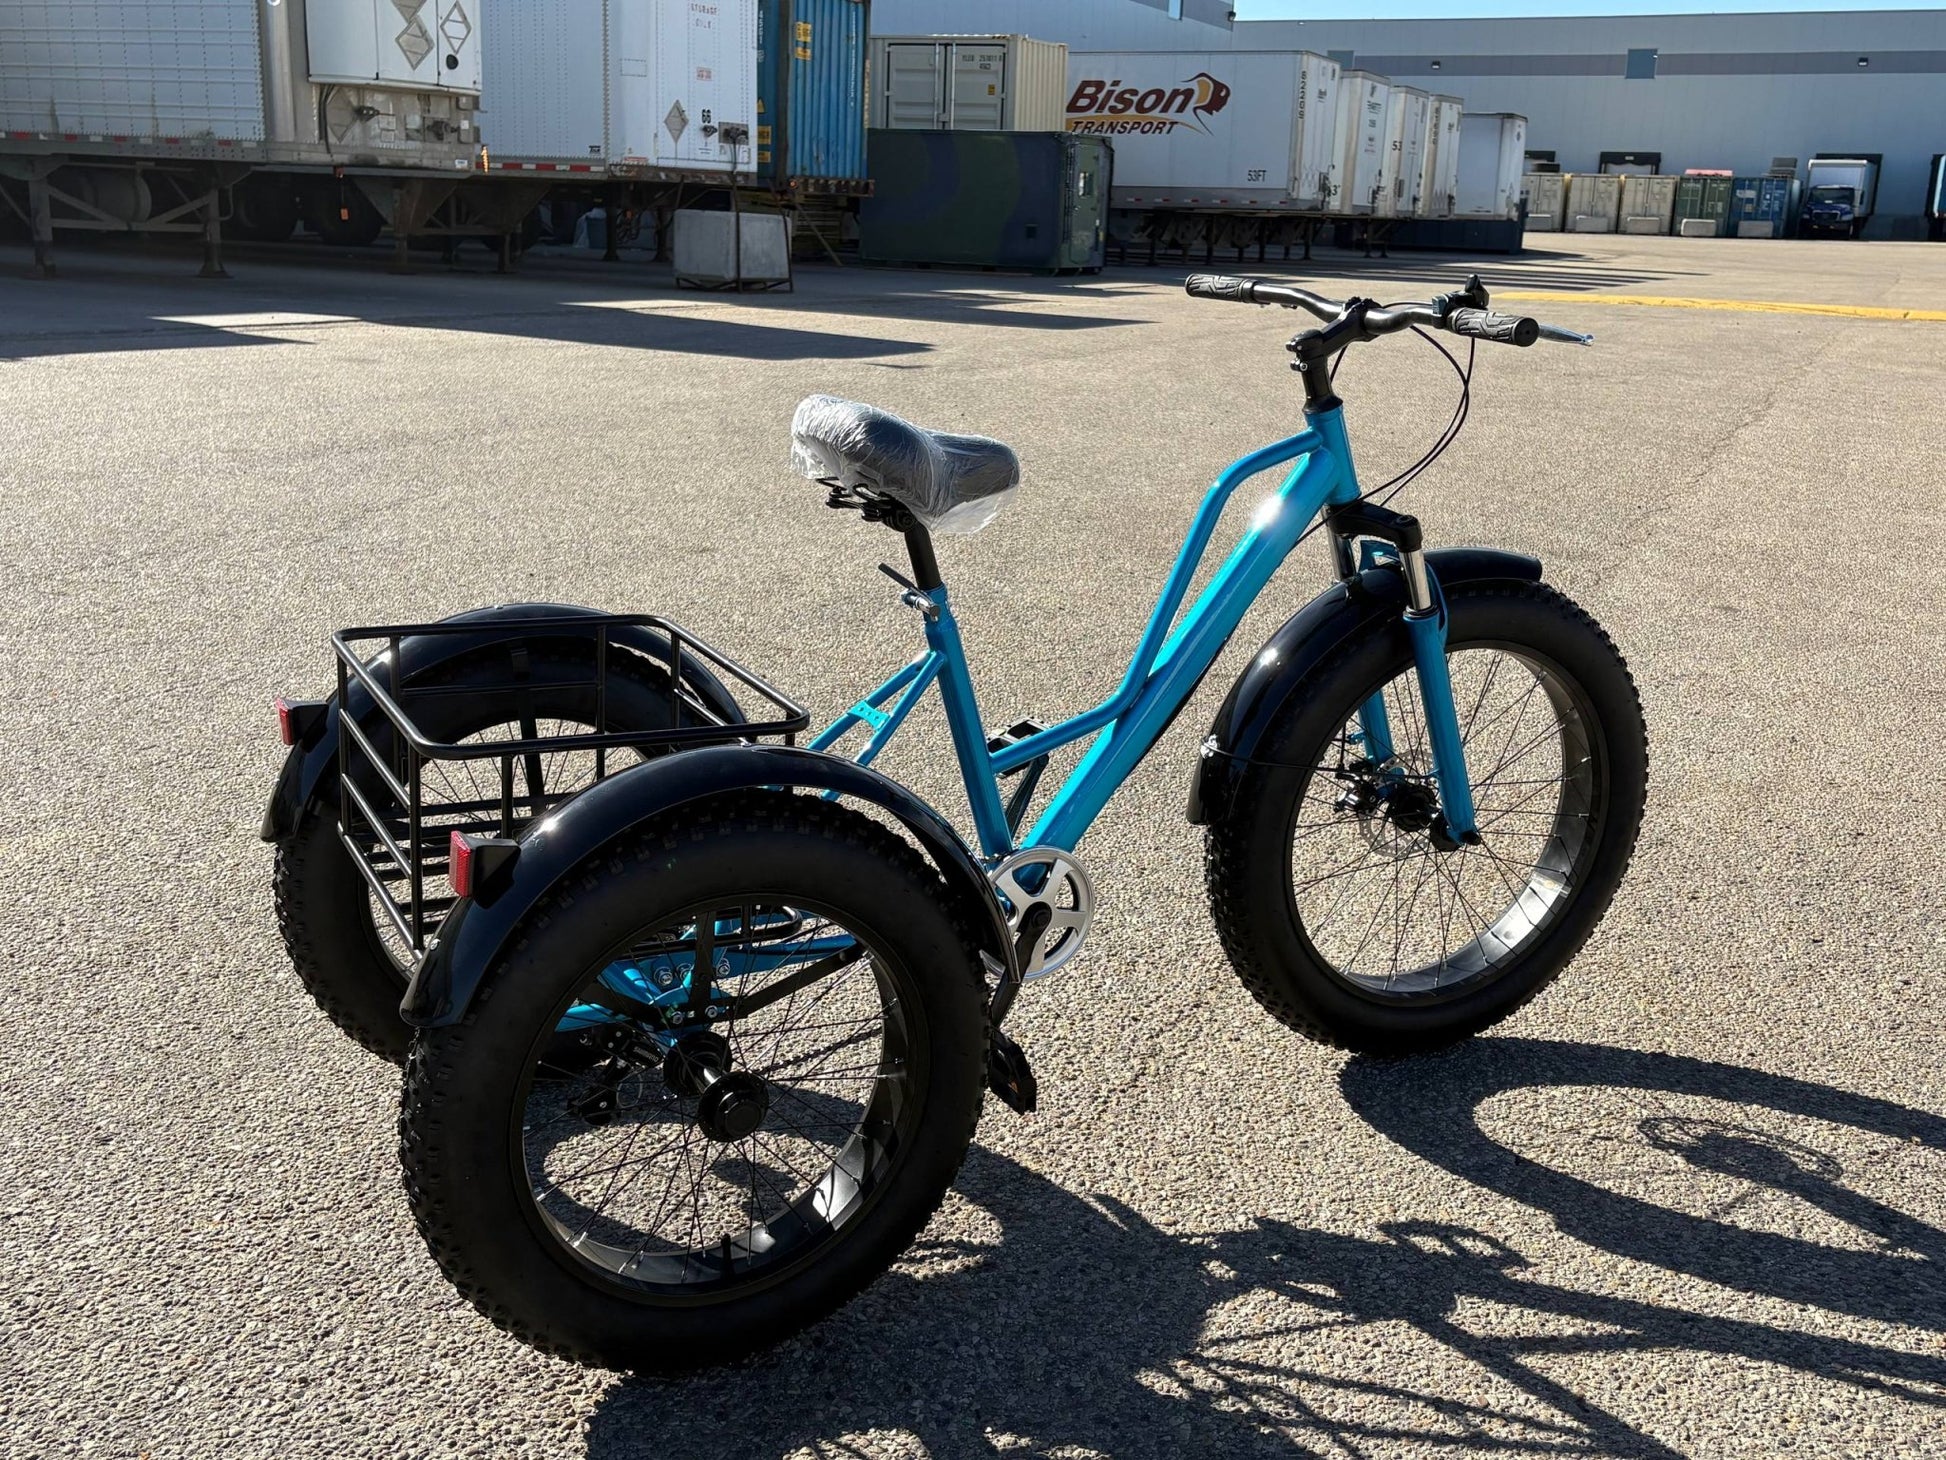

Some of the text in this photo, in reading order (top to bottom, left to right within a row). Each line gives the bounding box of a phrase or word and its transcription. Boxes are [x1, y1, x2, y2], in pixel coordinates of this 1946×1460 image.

[1066, 80, 1195, 114] Bison
[1072, 121, 1179, 135] TRANSPORT
[1247, 170, 1267, 182] 53FT
